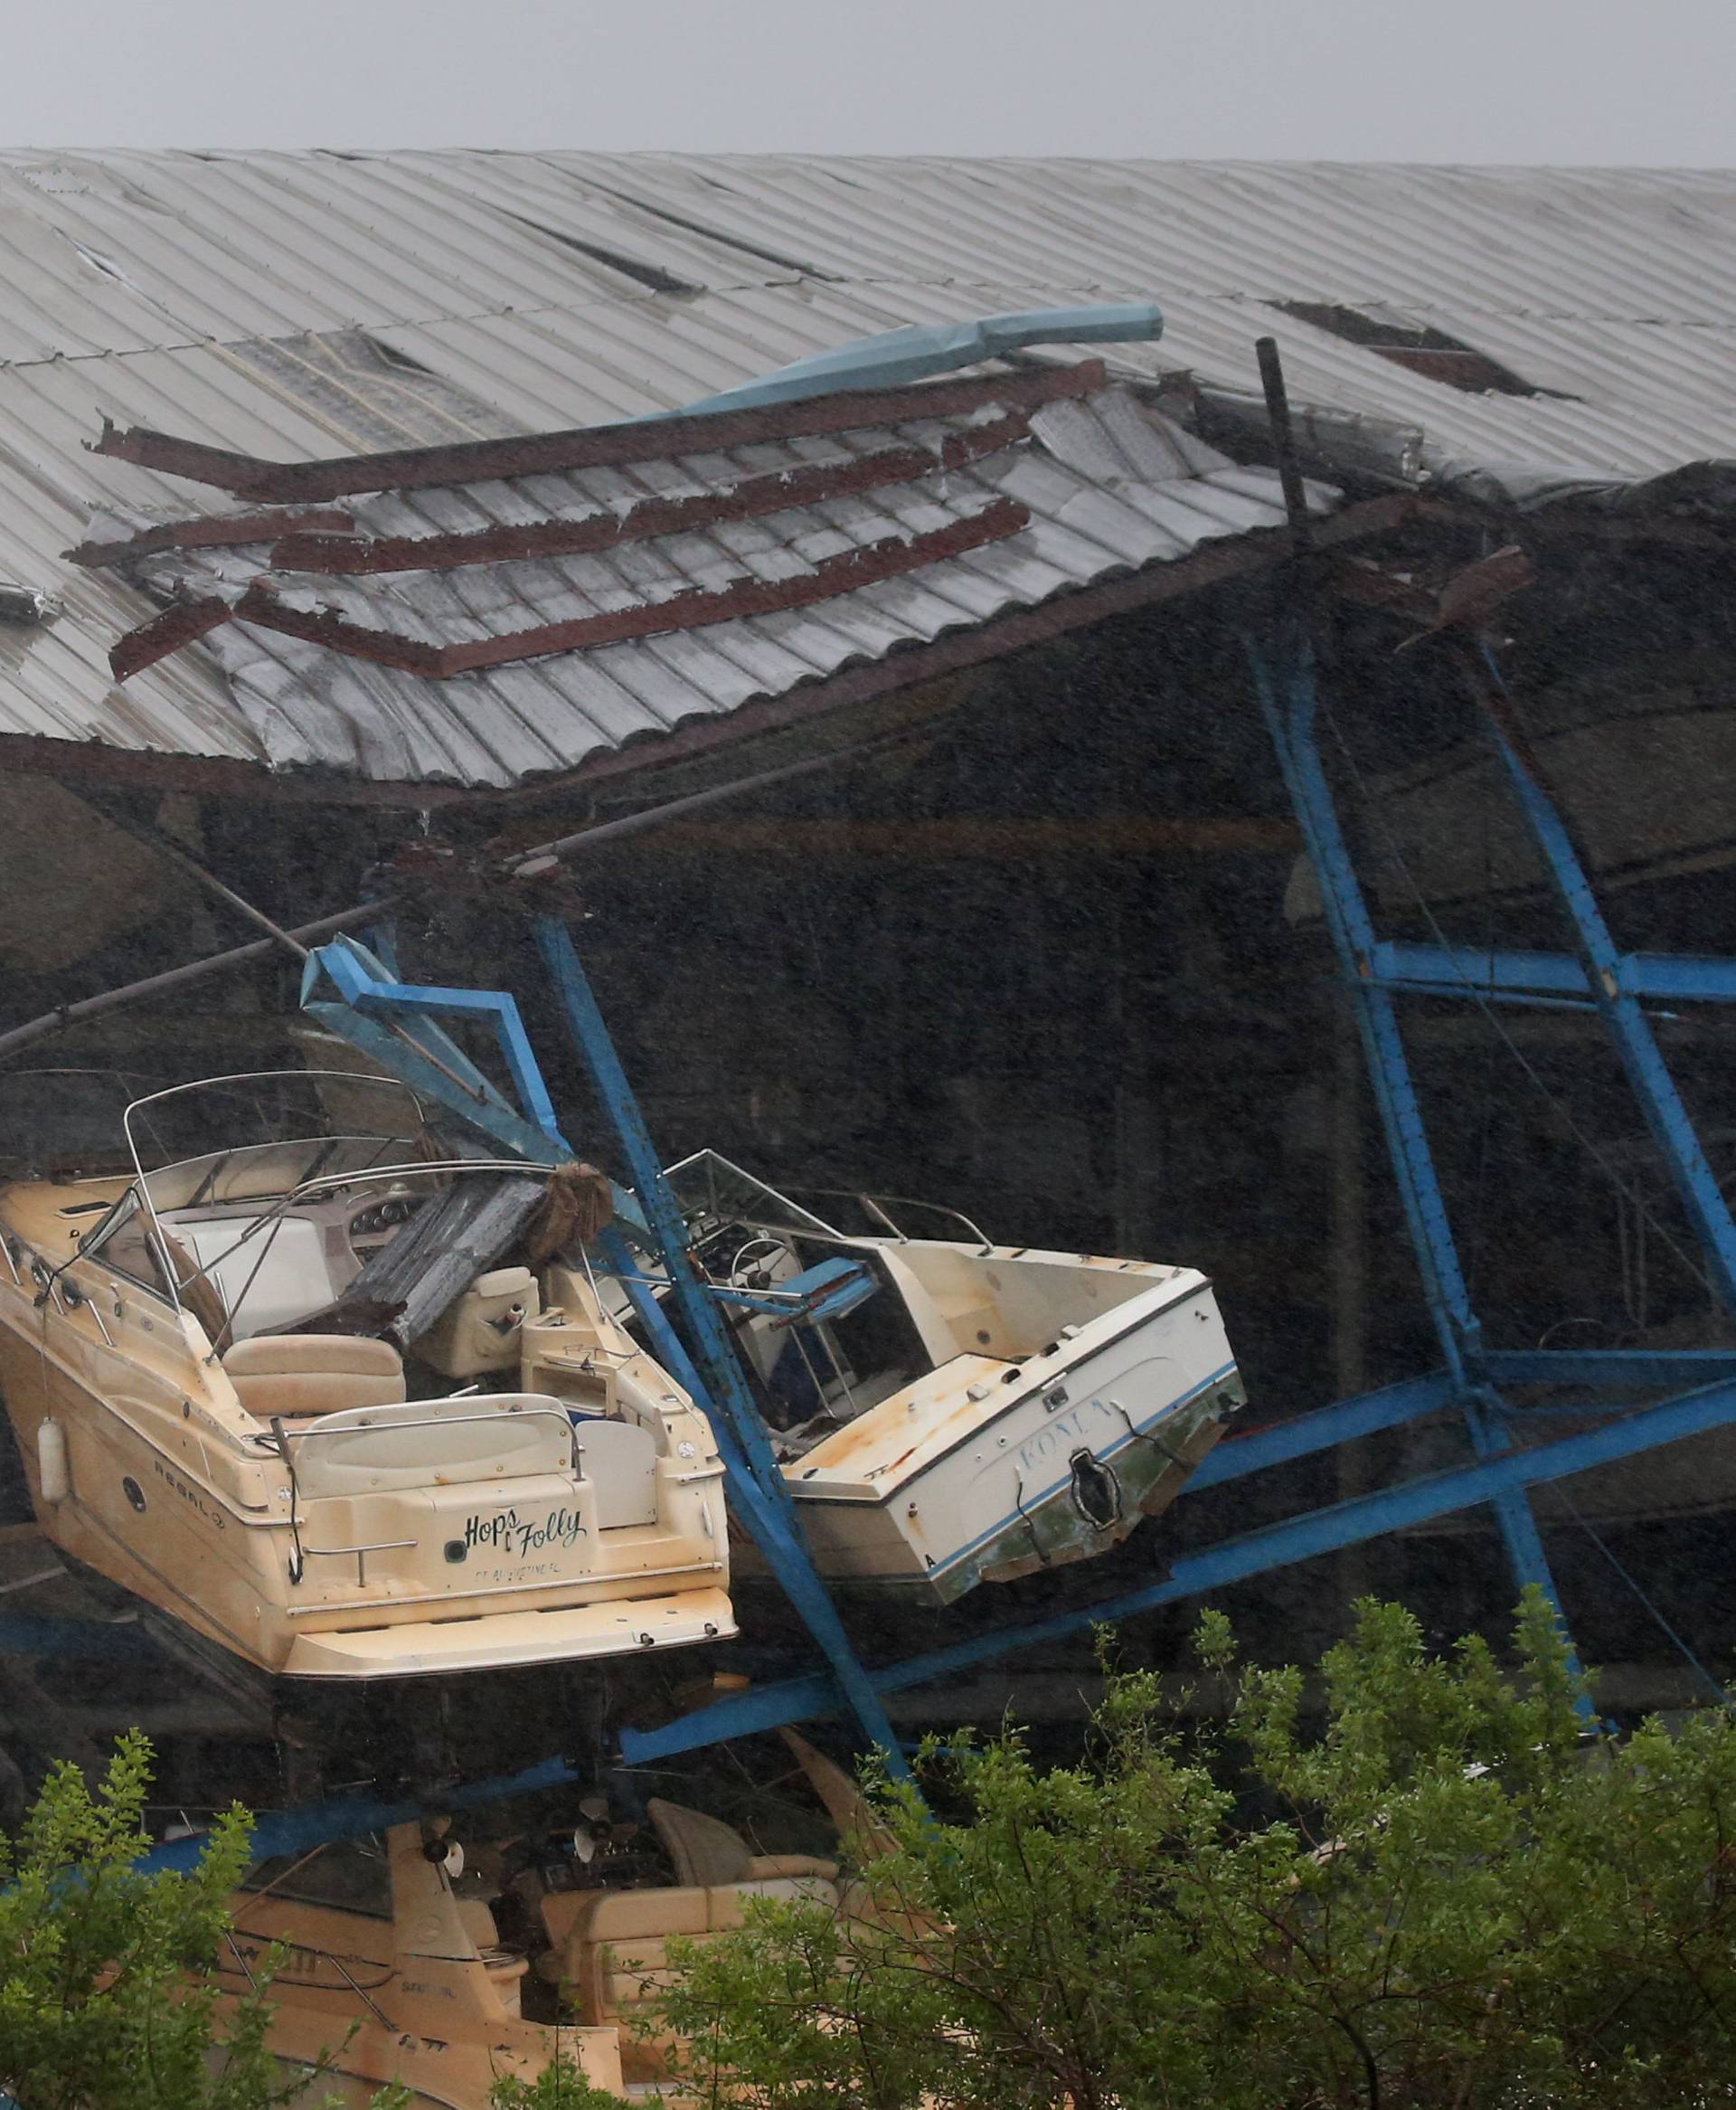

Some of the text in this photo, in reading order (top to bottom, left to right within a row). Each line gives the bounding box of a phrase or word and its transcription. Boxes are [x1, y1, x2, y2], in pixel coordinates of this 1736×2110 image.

[154, 1459, 209, 1518] REGAL
[464, 1508, 588, 1558] Hops Folly
